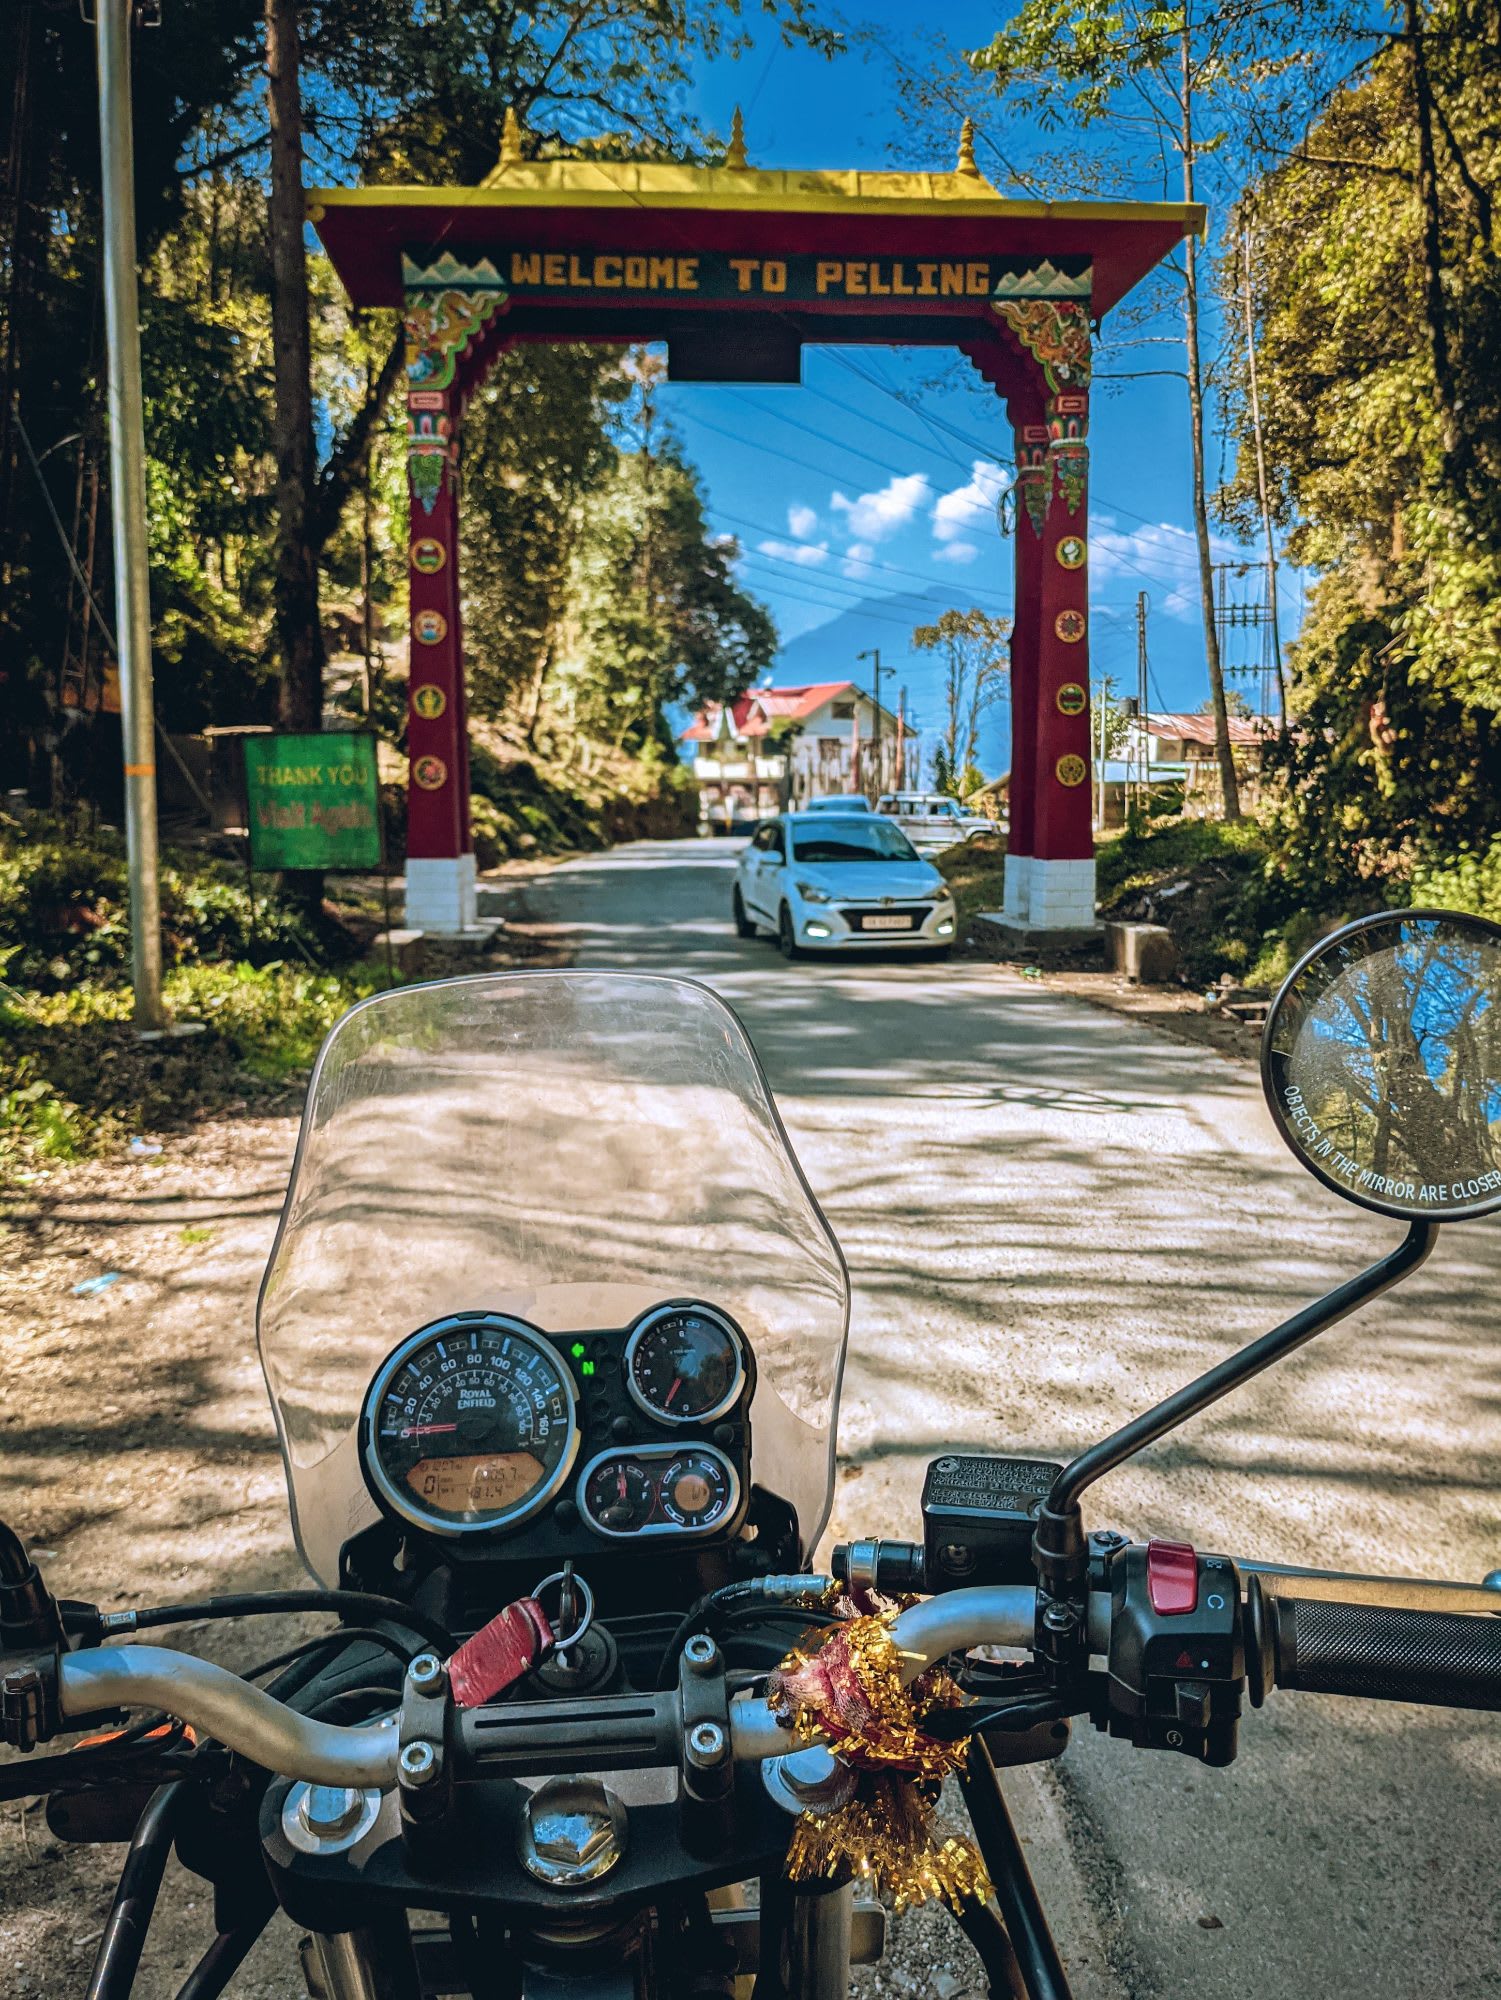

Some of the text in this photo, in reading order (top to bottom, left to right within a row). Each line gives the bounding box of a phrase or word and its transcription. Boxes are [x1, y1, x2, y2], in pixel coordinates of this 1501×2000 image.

[511, 253, 990, 296] WELCOME TO PELLING
[256, 763, 368, 786] THANK YOU
[1284, 1085, 1501, 1202] OBJECTS IN THE MIRROR ARE CLOSER
[440, 1358, 457, 1373] 60
[467, 1354, 482, 1364] 80
[490, 1355, 511, 1370] 100
[515, 1367, 533, 1386] 120
[582, 1361, 594, 1375] N
[419, 1374, 433, 1391] 40
[460, 1389, 491, 1399] ROYAL
[531, 1388, 546, 1409] 140
[404, 1397, 417, 1414] 20
[458, 1398, 496, 1409] ENFIELD
[539, 1414, 549, 1436] 160
[641, 1491, 648, 1500] F
